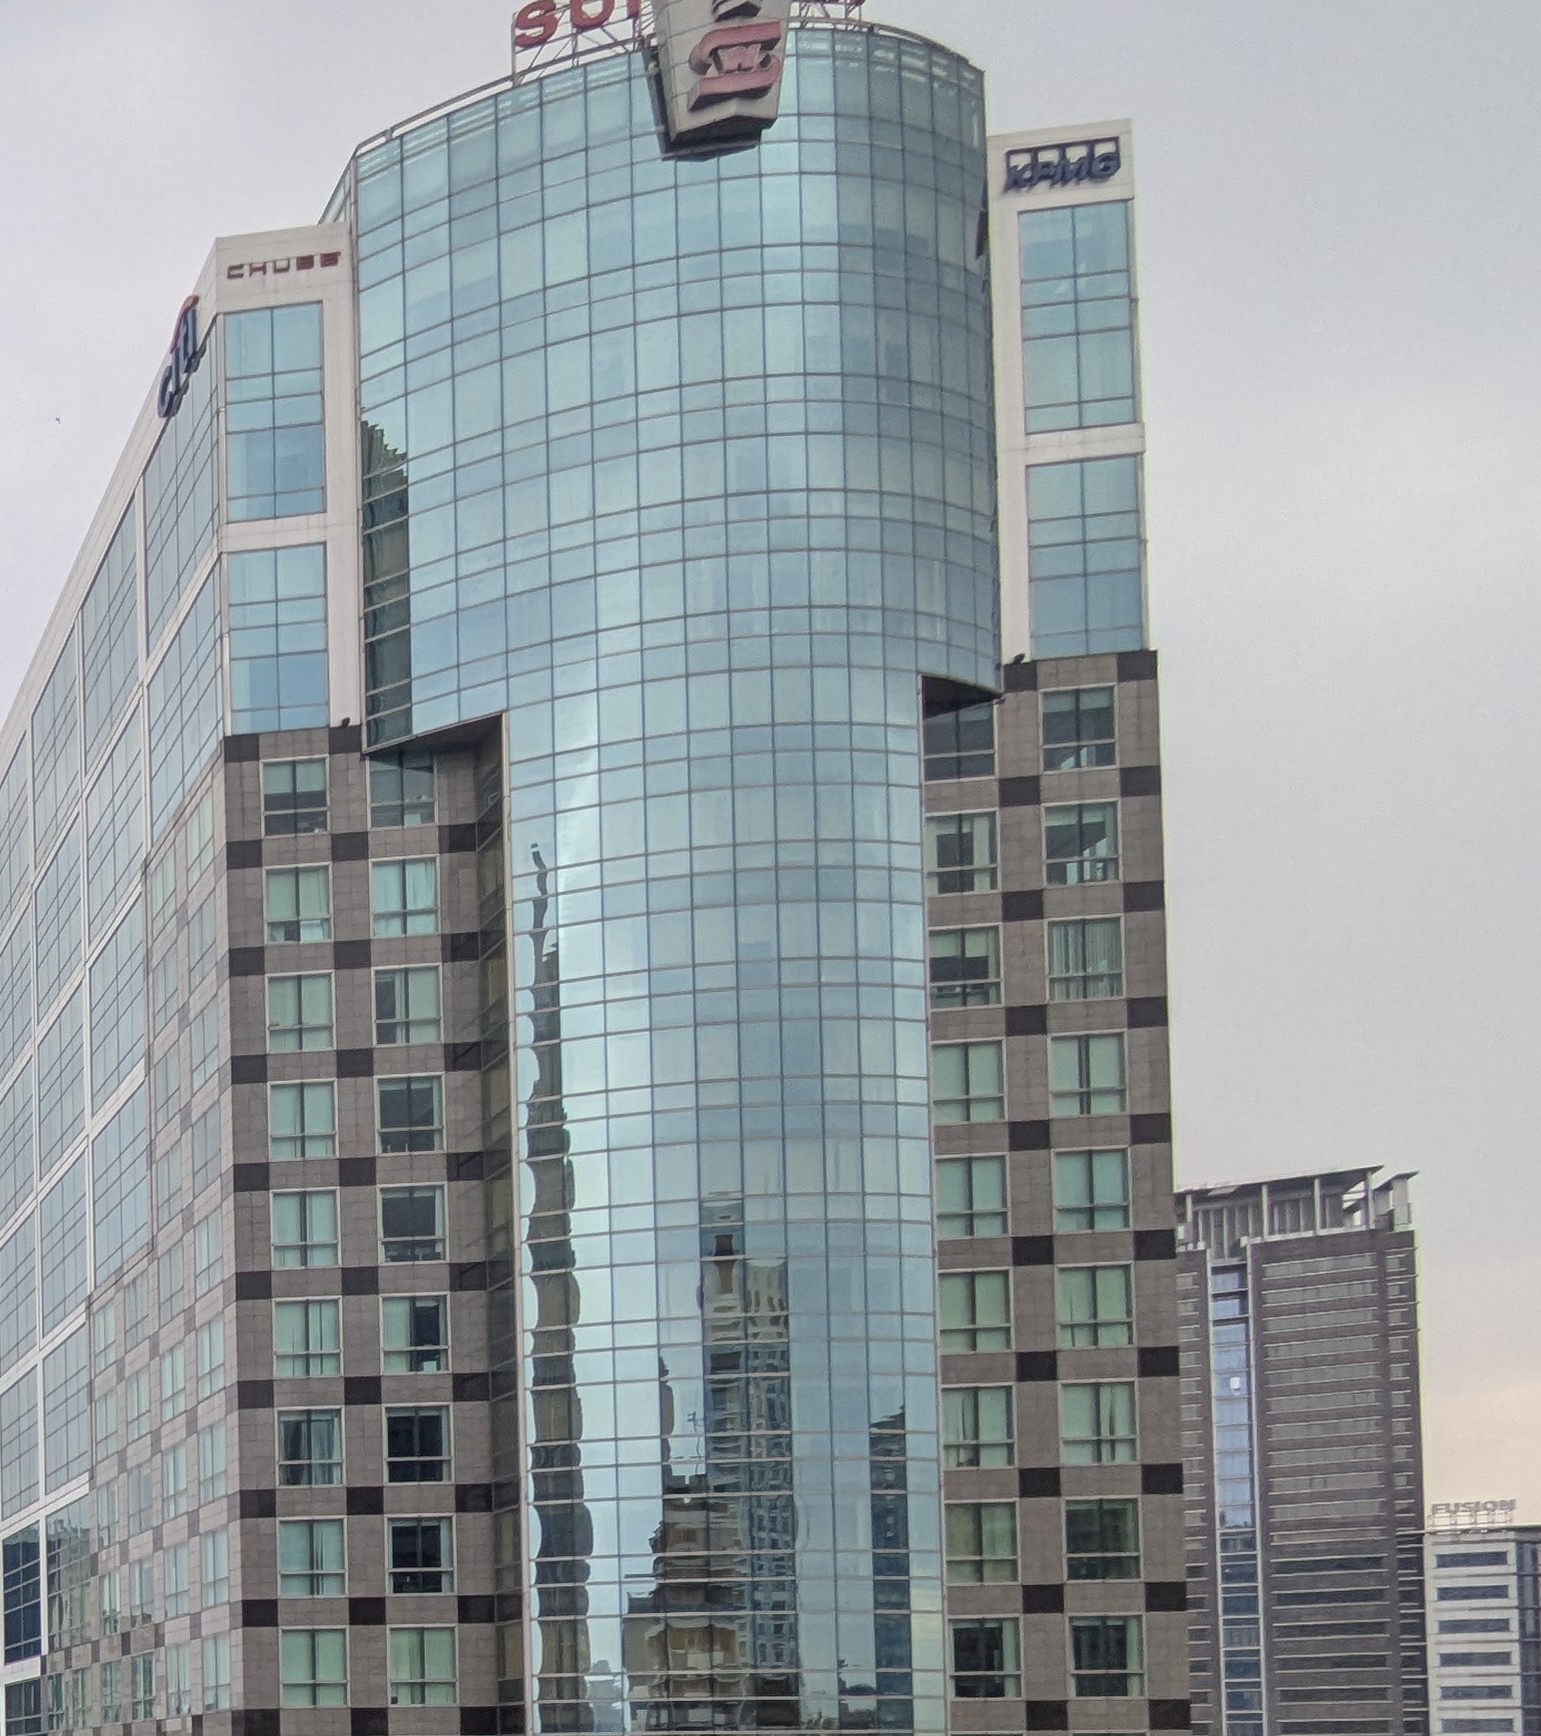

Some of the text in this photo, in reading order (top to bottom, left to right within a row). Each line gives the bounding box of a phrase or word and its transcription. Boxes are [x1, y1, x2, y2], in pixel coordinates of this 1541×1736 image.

[1002, 142, 1121, 194] KPMG
[227, 251, 341, 280] CHUBB
[1431, 1499, 1516, 1515] FUSION
